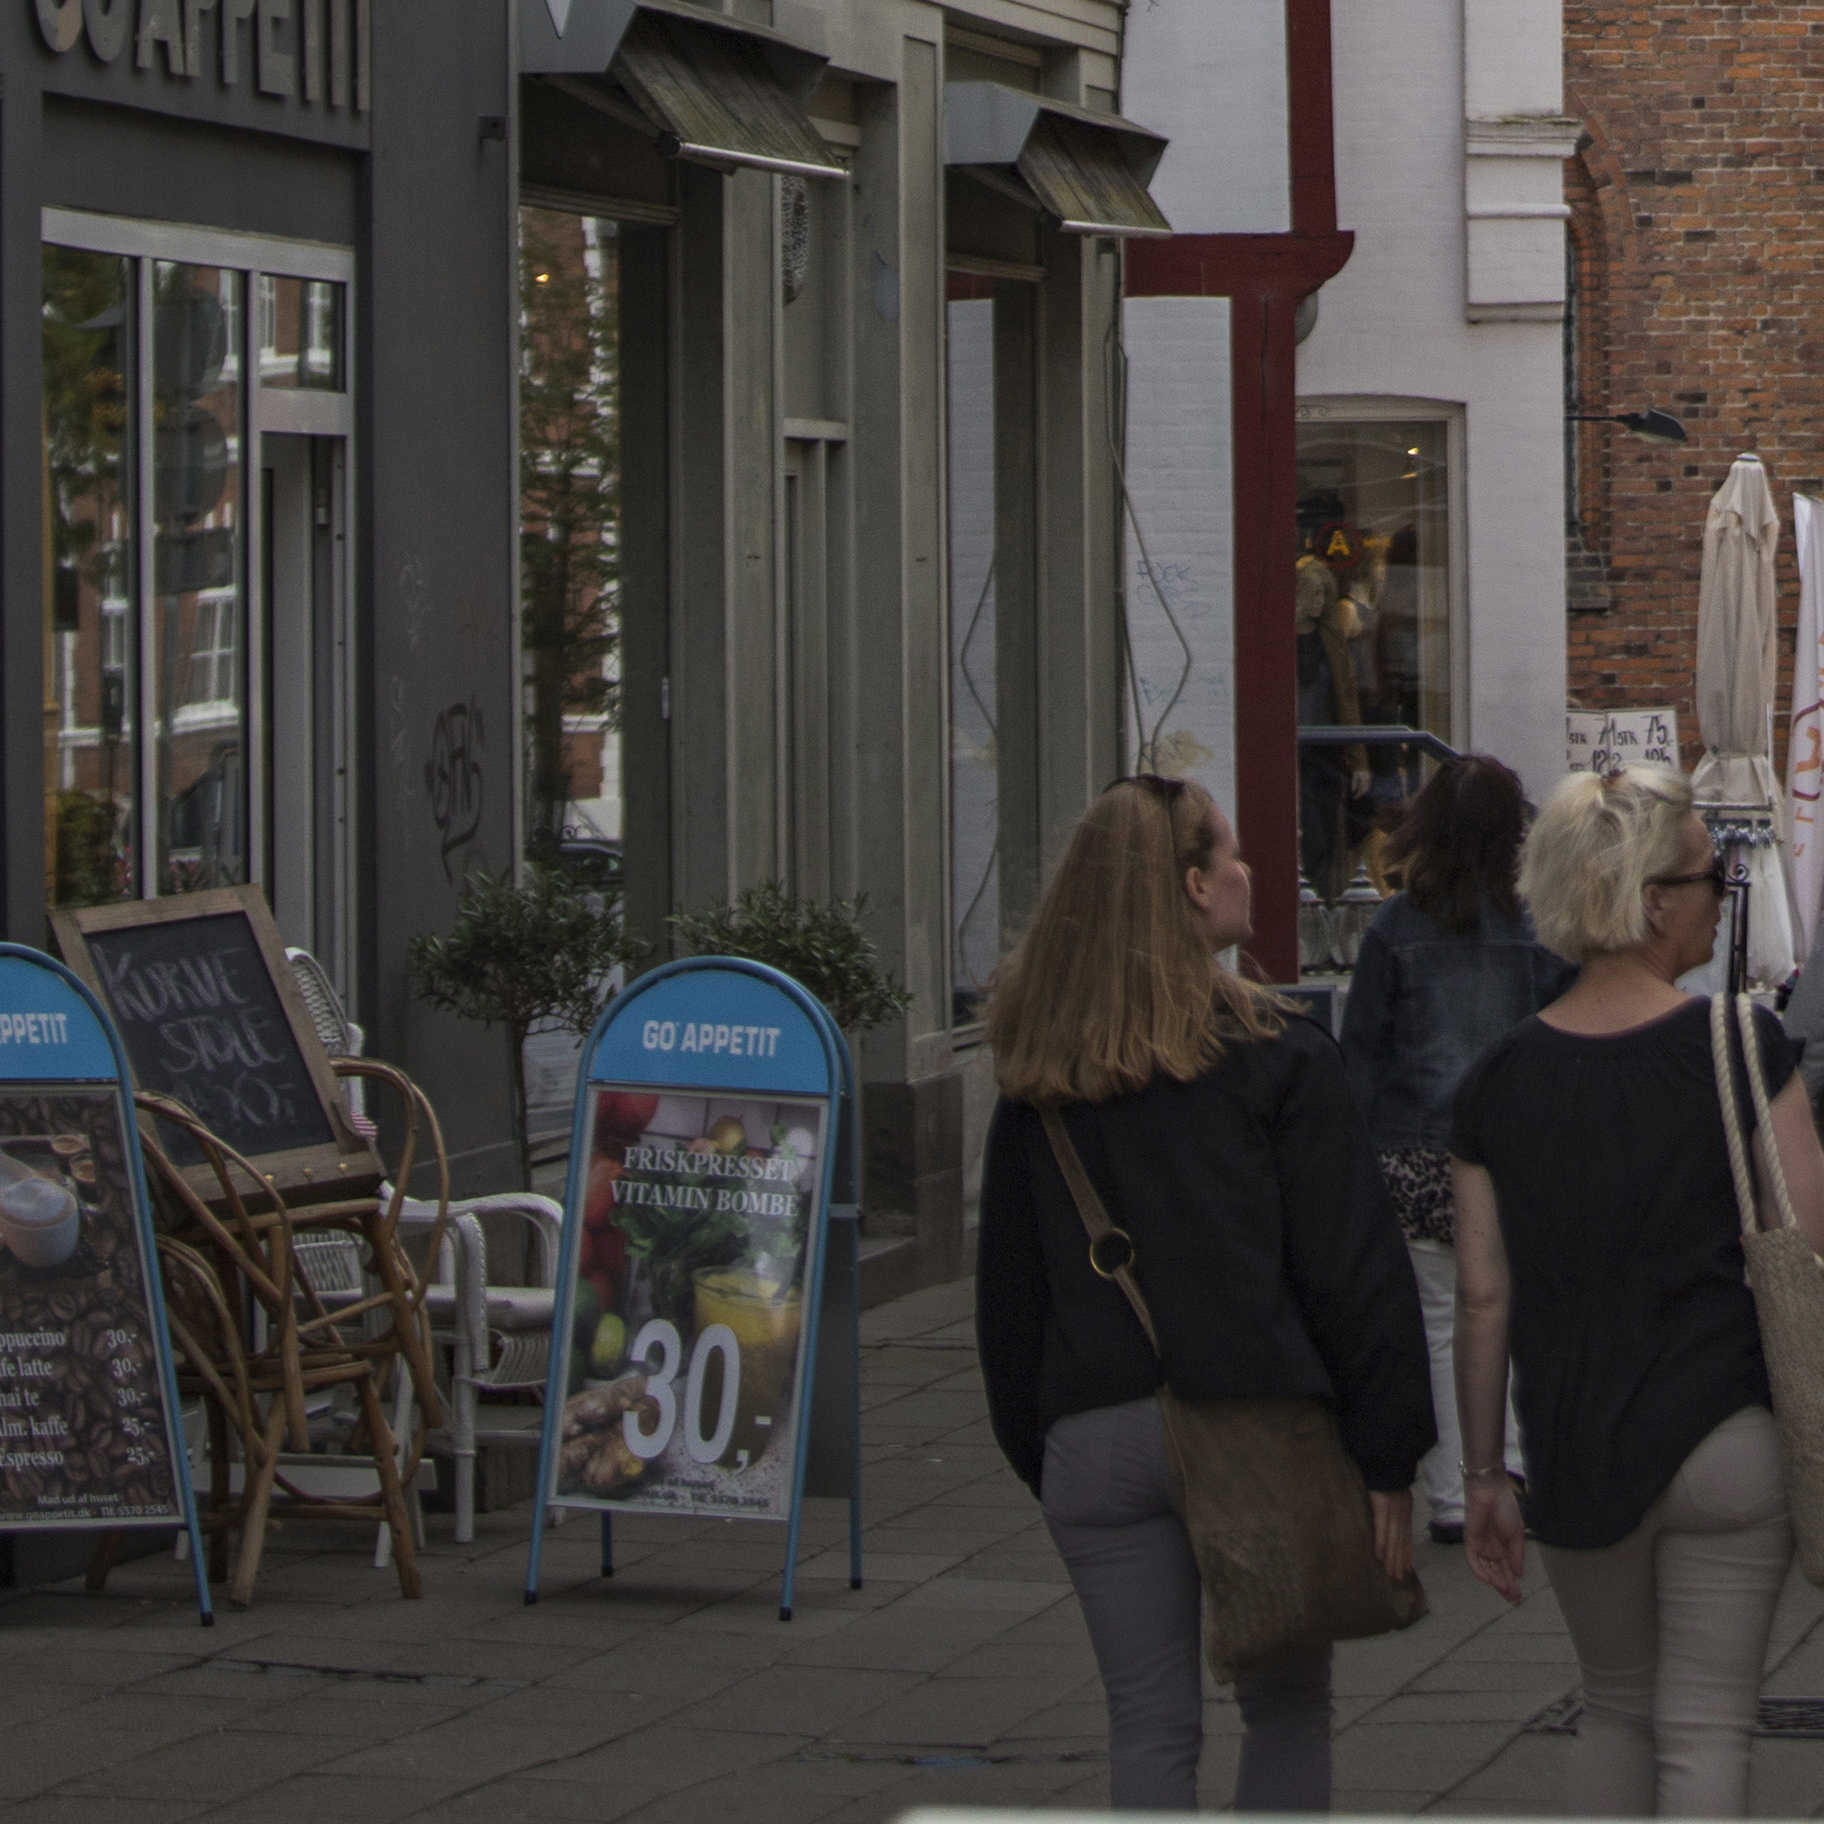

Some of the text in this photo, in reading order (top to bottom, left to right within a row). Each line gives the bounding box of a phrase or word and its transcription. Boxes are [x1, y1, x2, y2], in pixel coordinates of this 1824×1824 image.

[623, 1145, 794, 1182] FRISKPRESSET
[611, 1180, 800, 1217] VITAMIN BOMBE
[17, 1356, 54, 1377] latte
[24, 1388, 41, 1406] te
[30, 1415, 69, 1436] kaffe
